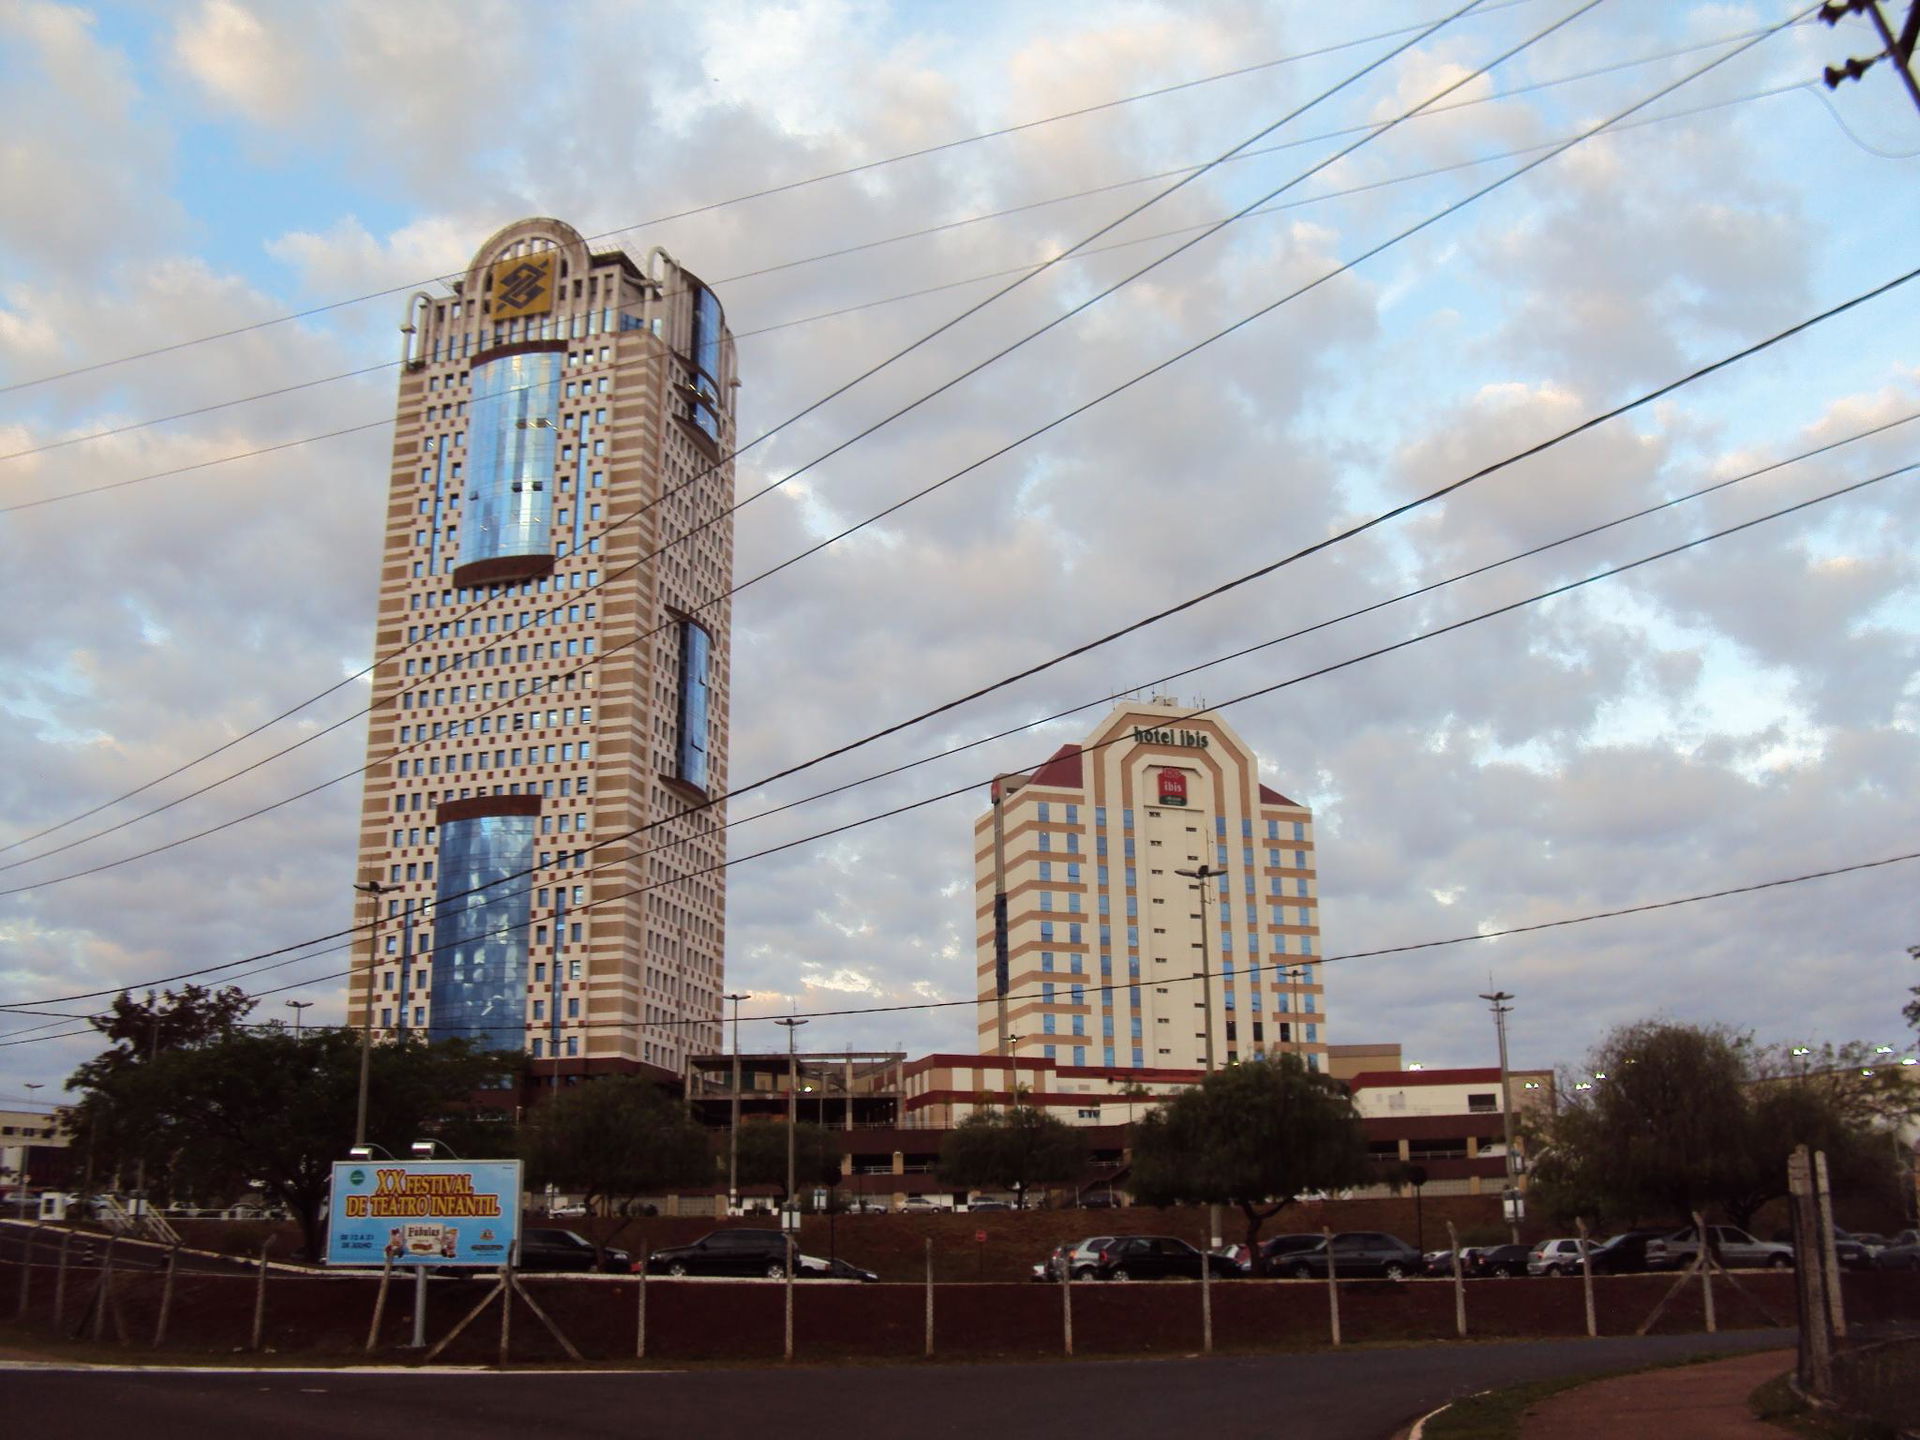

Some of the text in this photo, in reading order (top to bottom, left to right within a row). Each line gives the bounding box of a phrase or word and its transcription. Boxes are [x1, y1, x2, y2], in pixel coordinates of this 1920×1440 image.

[1134, 726, 1209, 748] hotel ibis
[1164, 780, 1182, 792] ibis
[376, 1169, 405, 1195] XX
[405, 1174, 473, 1194] FESTIVAL
[346, 1194, 501, 1217] DE TEATRO INFANTIL
